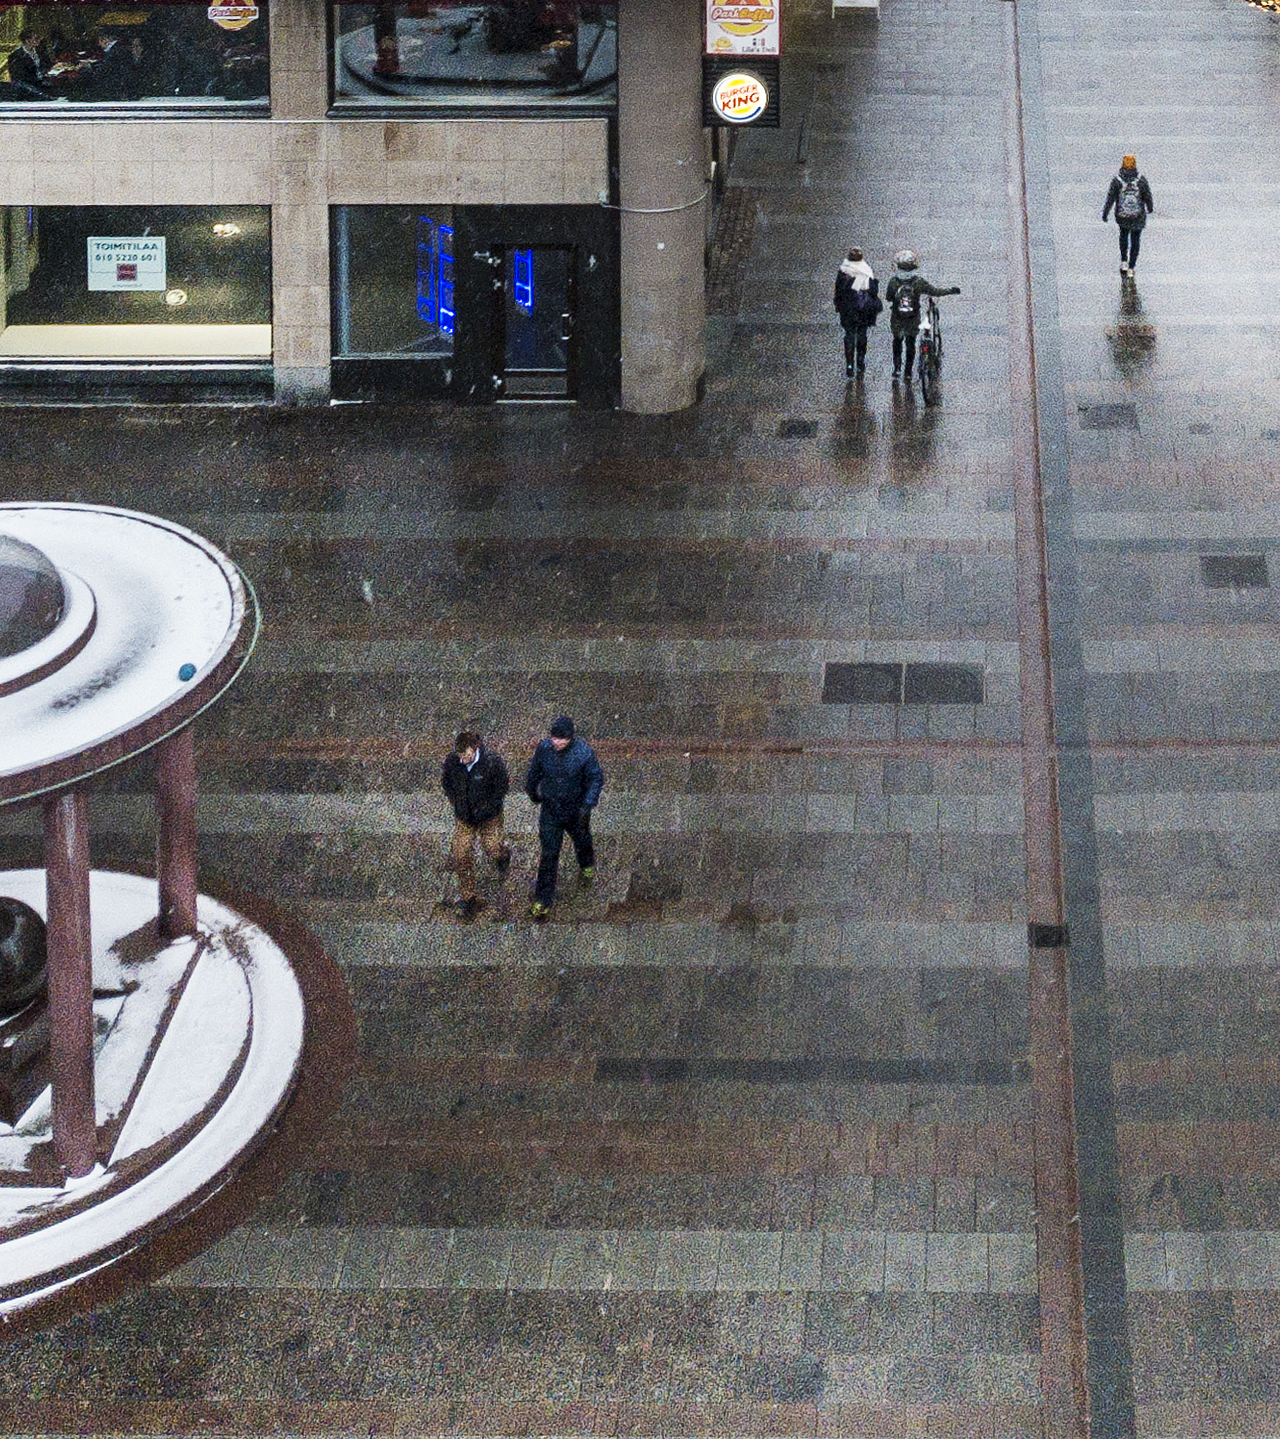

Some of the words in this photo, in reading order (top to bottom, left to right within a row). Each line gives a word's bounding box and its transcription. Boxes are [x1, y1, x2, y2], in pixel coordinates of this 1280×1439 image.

[721, 84, 757, 100] BURGER
[722, 92, 760, 111] KING
[94, 242, 158, 250] TOIMITILAA
